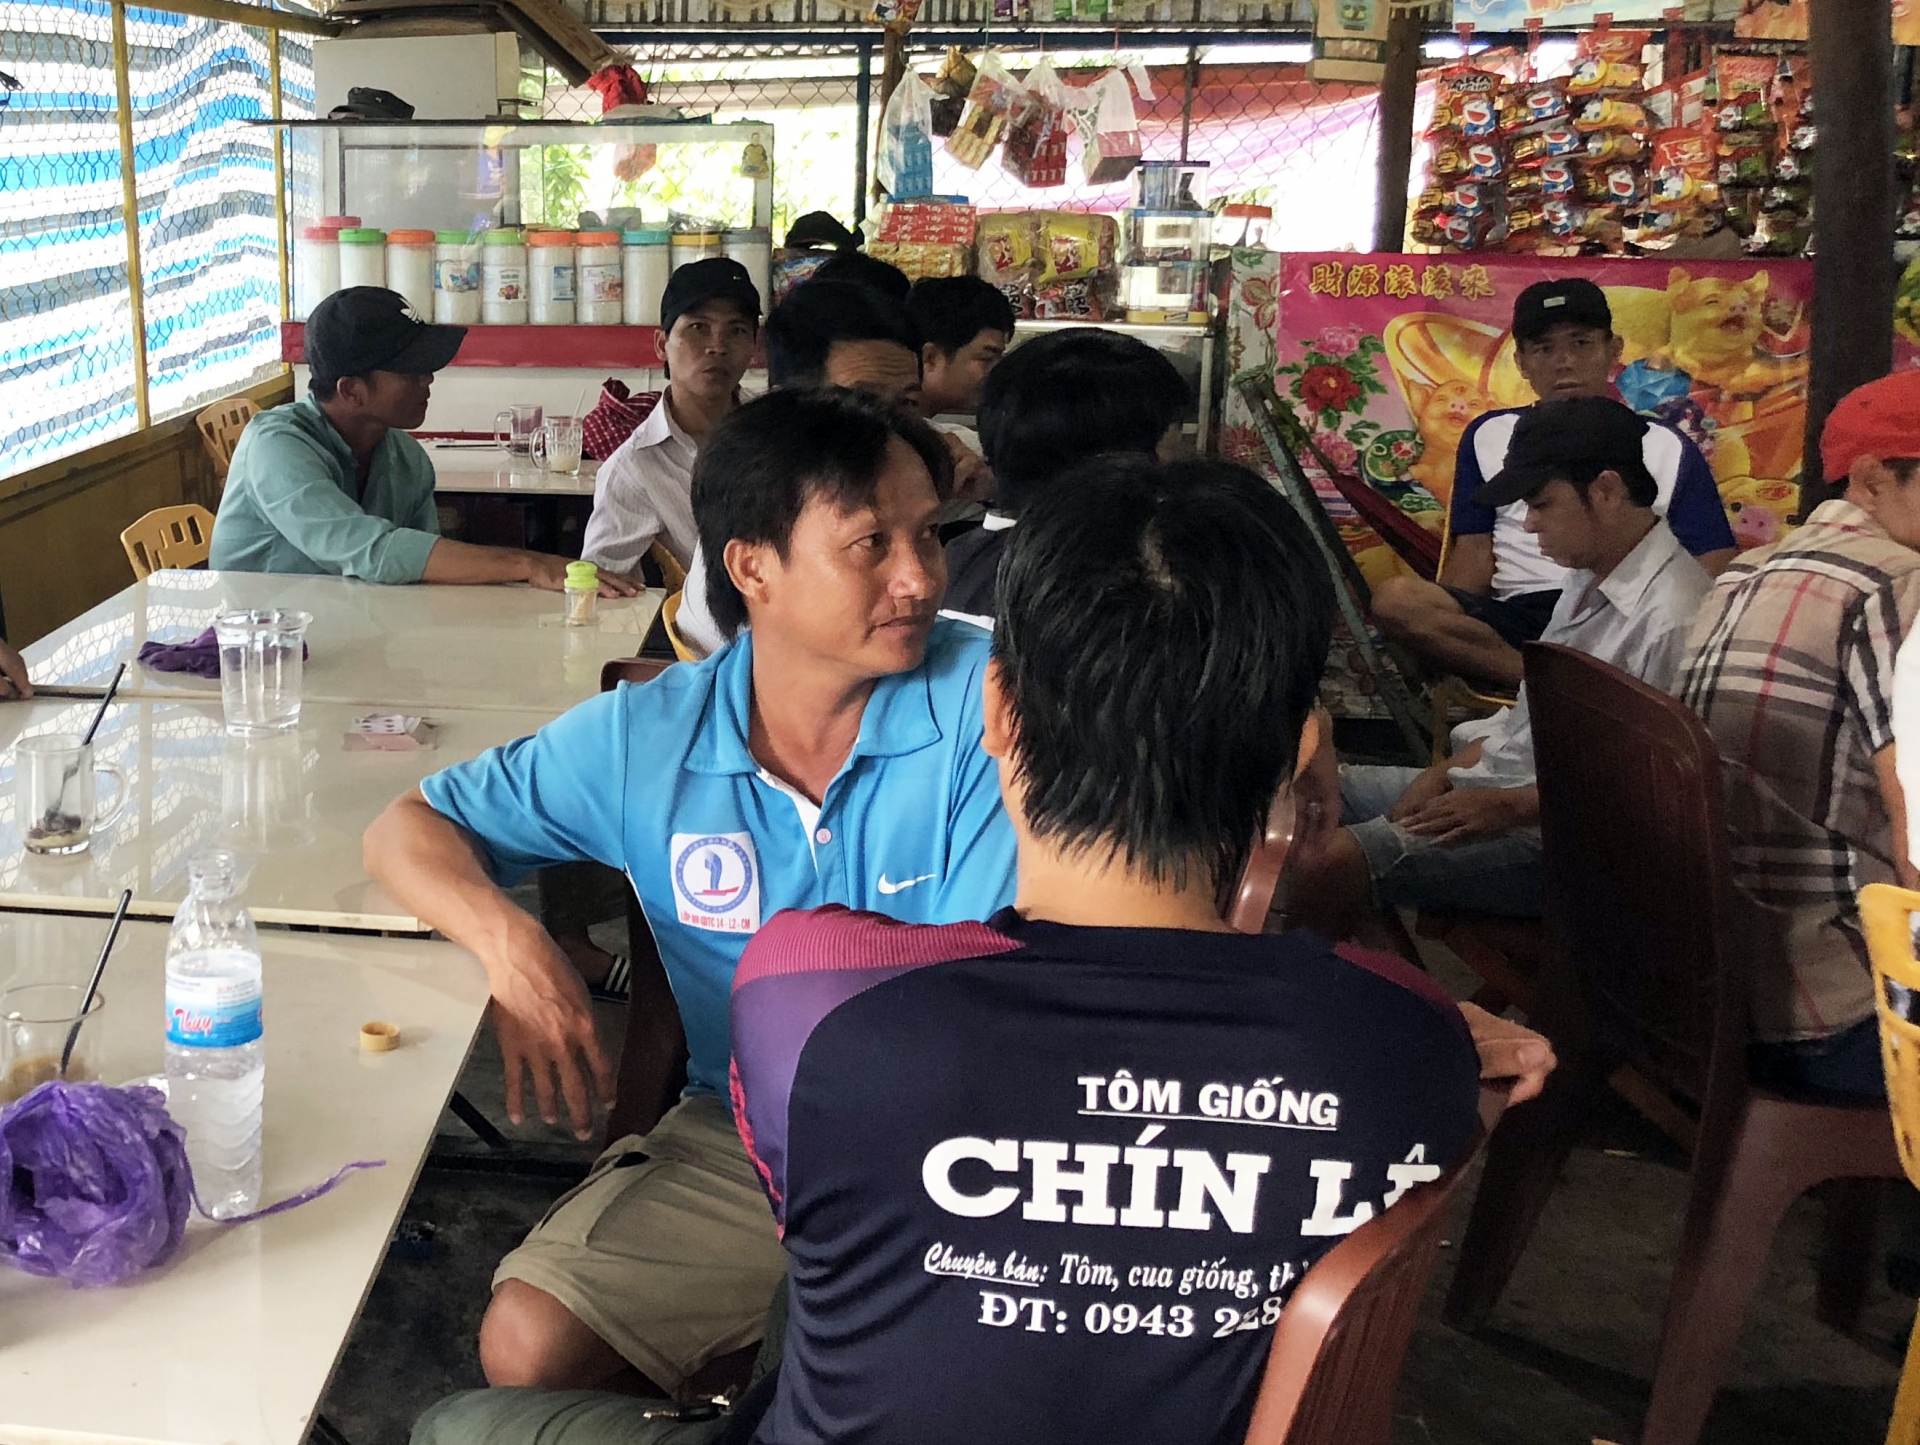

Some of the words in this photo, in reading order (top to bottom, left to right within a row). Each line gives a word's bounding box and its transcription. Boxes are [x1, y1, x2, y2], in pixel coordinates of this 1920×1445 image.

[1077, 1069, 1182, 1114] TÔM
[1198, 1076, 1339, 1126] GIỐNG
[922, 1123, 1271, 1233] CHÍN
[924, 1241, 997, 1279] Chuyên
[1003, 1250, 1048, 1283] bán:
[1060, 1253, 1119, 1293] Tôm,
[1128, 1265, 1173, 1288] cua
[1177, 1255, 1259, 1299] giống,
[977, 1290, 1067, 1334] ĐT:
[1084, 1302, 1195, 1338] 0943
